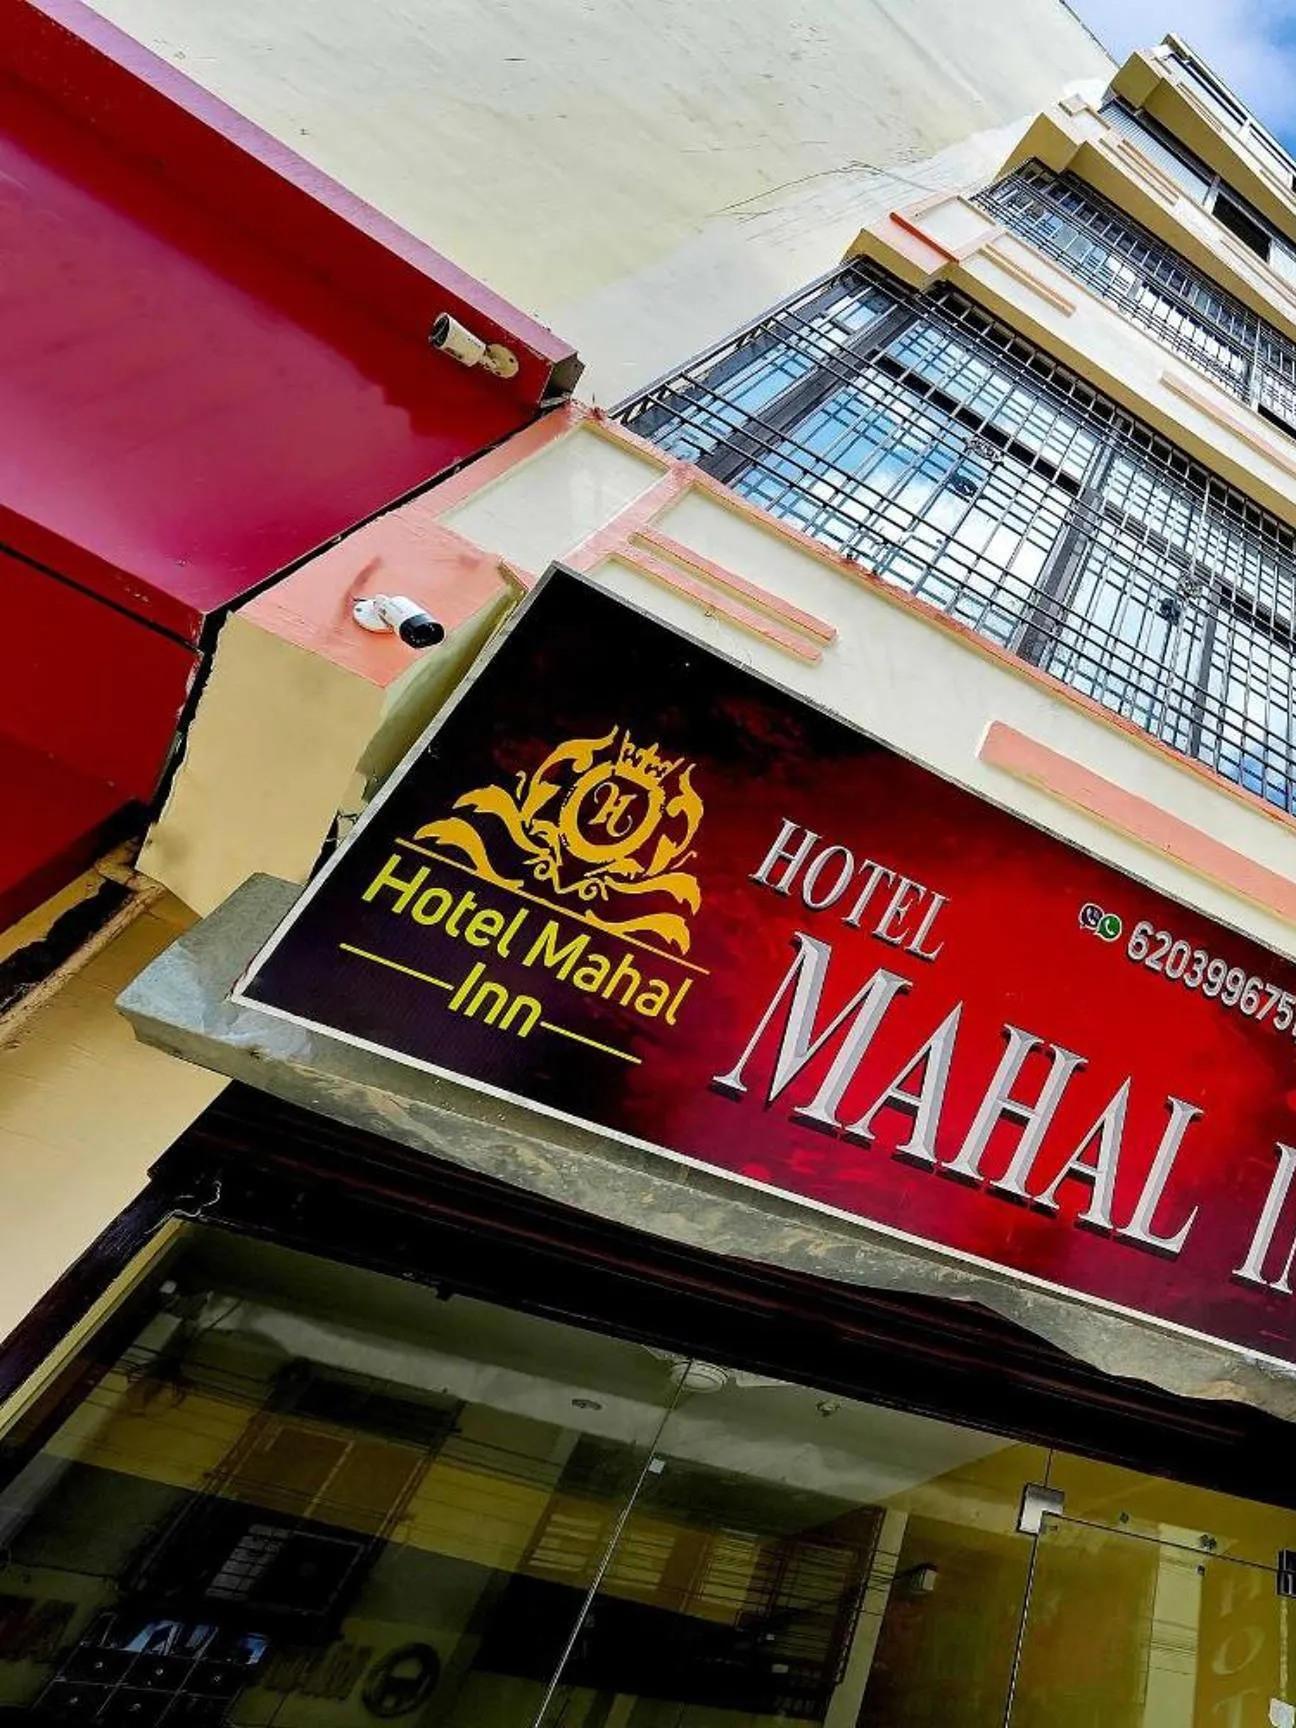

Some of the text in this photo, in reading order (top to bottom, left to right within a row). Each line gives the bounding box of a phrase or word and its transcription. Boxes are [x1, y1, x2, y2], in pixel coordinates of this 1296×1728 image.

[361, 854, 693, 1025] Hotel Mahal
[748, 817, 951, 961] HOTEL
[448, 962, 542, 1037] Inn
[709, 931, 1204, 1255] MAHAL
